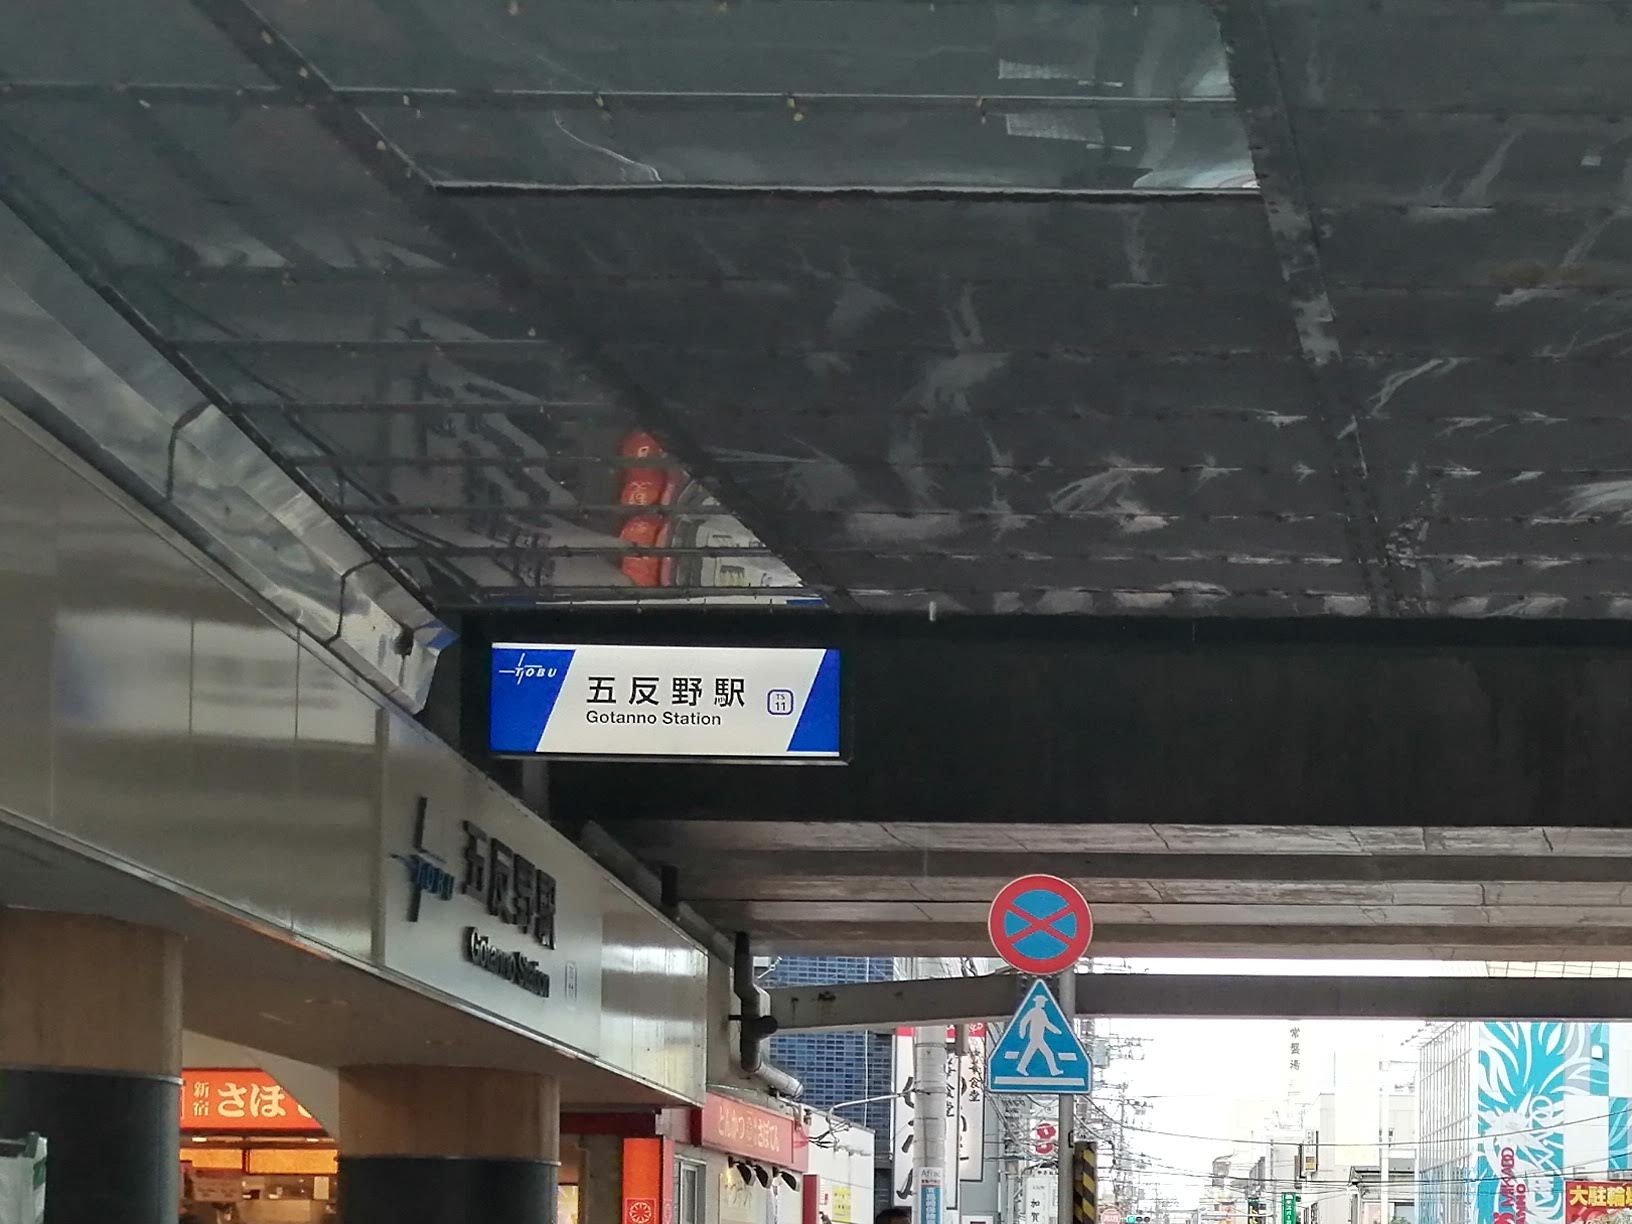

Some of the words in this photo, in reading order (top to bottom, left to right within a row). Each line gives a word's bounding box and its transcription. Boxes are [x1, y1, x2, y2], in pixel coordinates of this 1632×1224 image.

[586, 676, 745, 707] 五反野駅
[775, 702, 787, 711] 11
[586, 711, 657, 725] Gotanno
[662, 711, 721, 726] Station
[461, 819, 557, 951] 五反野駅
[1290, 1027, 1301, 1070] 常盤湯
[192, 1081, 209, 1116] 新宿
[1500, 1146, 1515, 1207] MIKADO
